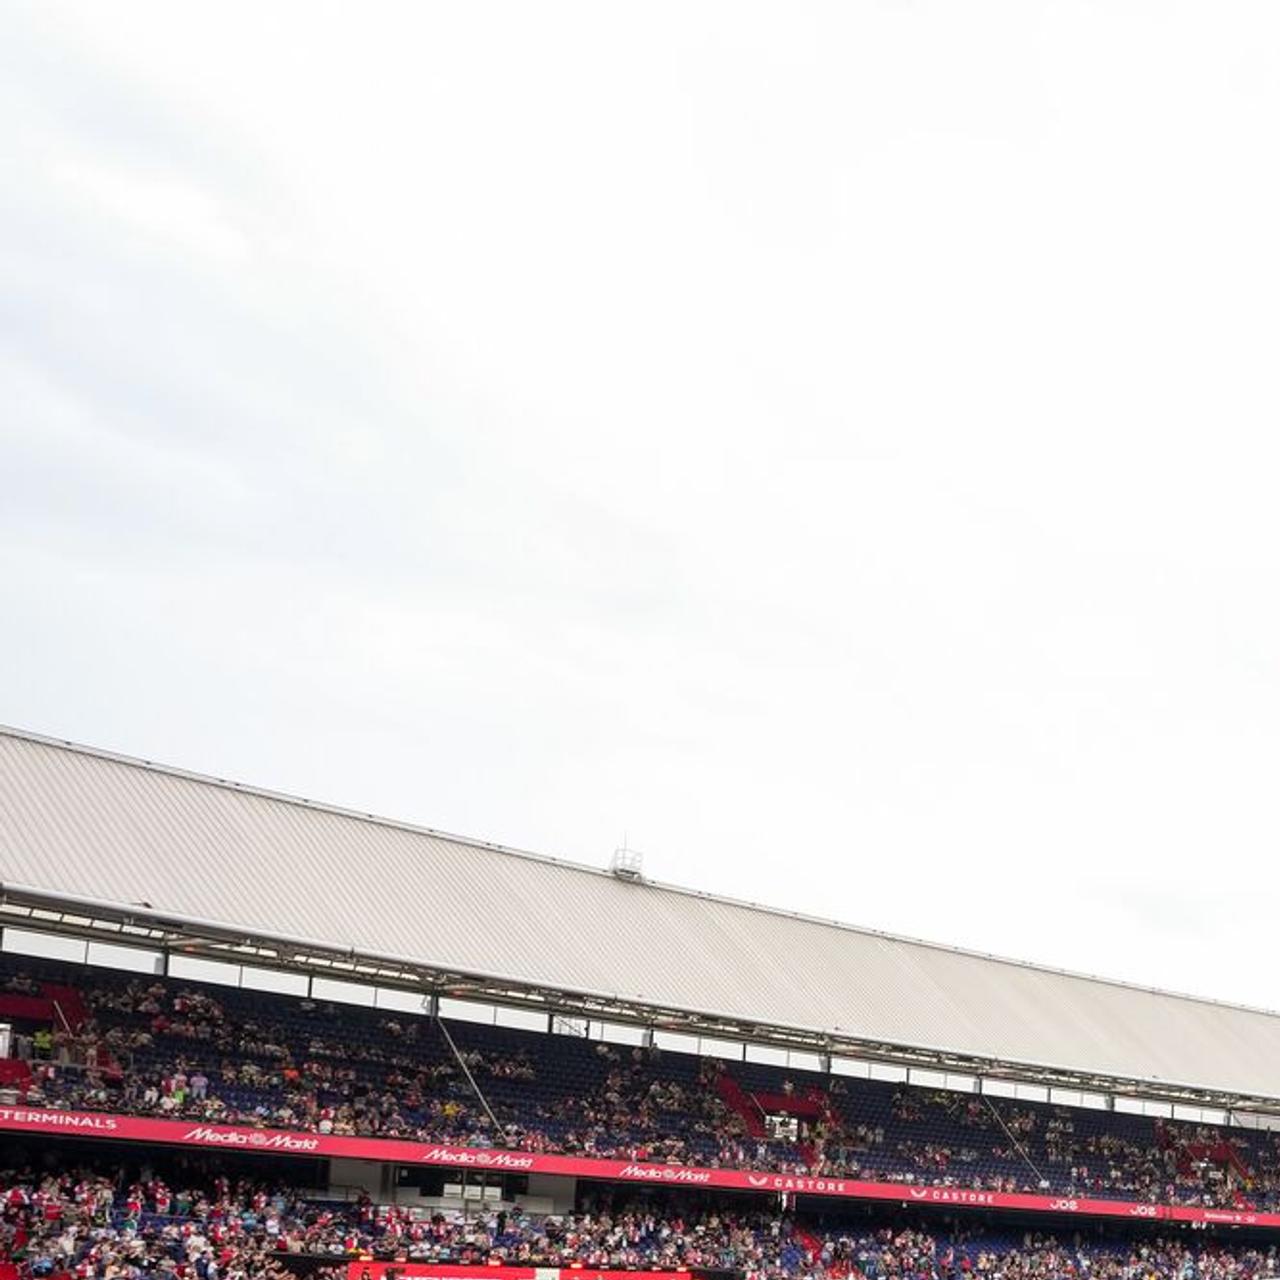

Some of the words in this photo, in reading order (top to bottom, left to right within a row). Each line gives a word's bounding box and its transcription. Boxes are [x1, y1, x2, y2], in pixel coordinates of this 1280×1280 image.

[0, 1109, 117, 1130] TERMINALS
[774, 1176, 846, 1191] CASTORE
[932, 1191, 994, 1203] CASTORE
